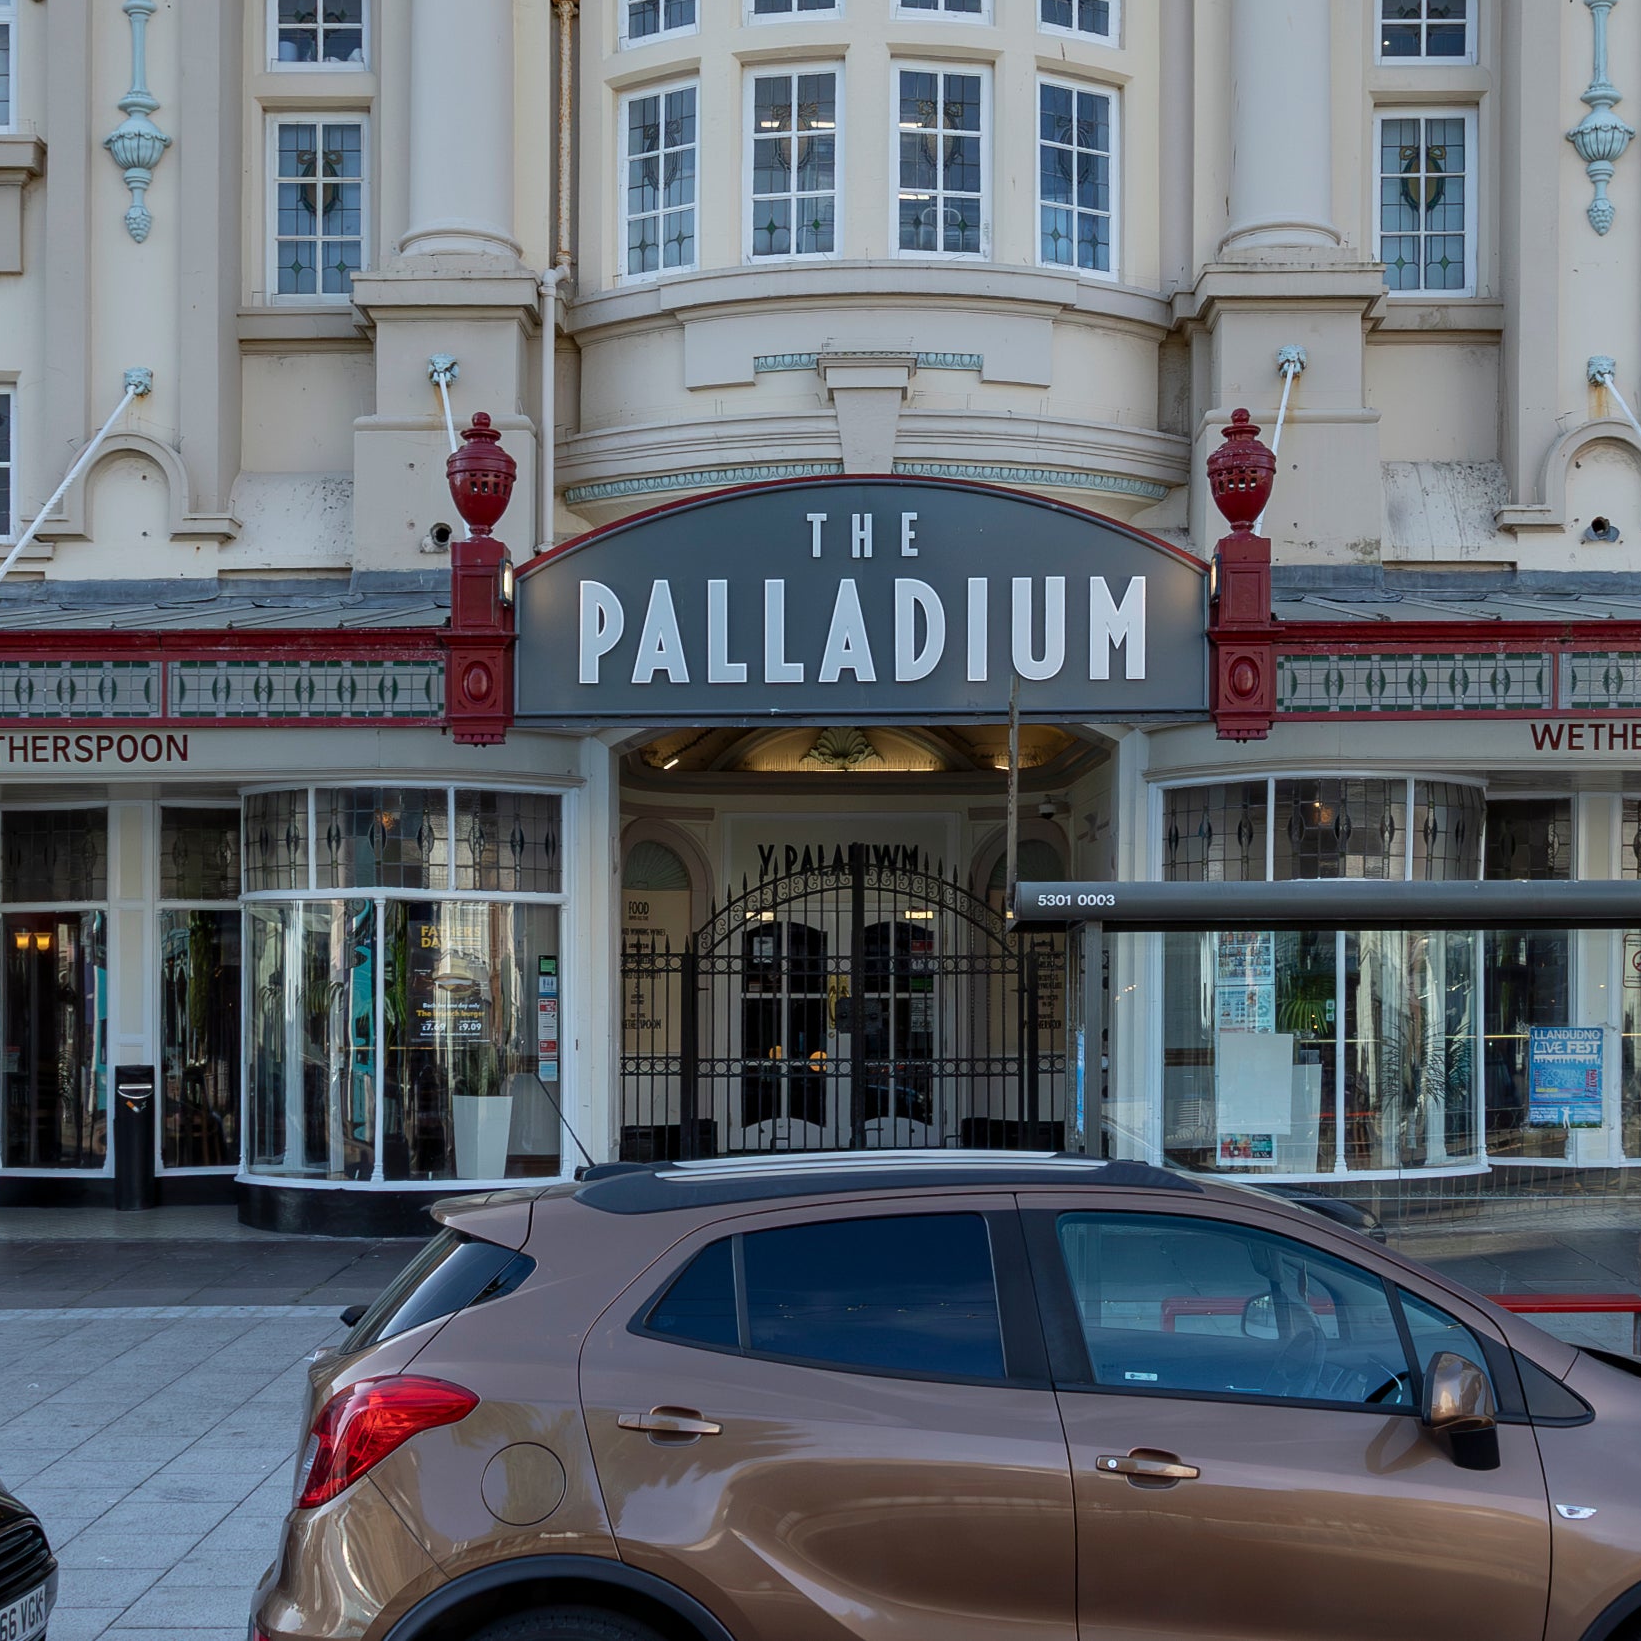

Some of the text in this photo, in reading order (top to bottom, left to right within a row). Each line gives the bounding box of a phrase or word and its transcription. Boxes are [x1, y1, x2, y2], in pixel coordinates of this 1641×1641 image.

[806, 512, 918, 558] THE
[578, 575, 1146, 685] PALLADIUM
[757, 844, 918, 876] Y PALAIWM
[1038, 894, 1116, 906] 5301 0003
[628, 901, 650, 915] FOOD
[416, 1009, 432, 1017] The
[1534, 1029, 1601, 1040] LLANDUDNO
[1533, 1041, 1600, 1054] LIVE FEST
[20, 1590, 44, 1633] VGK
